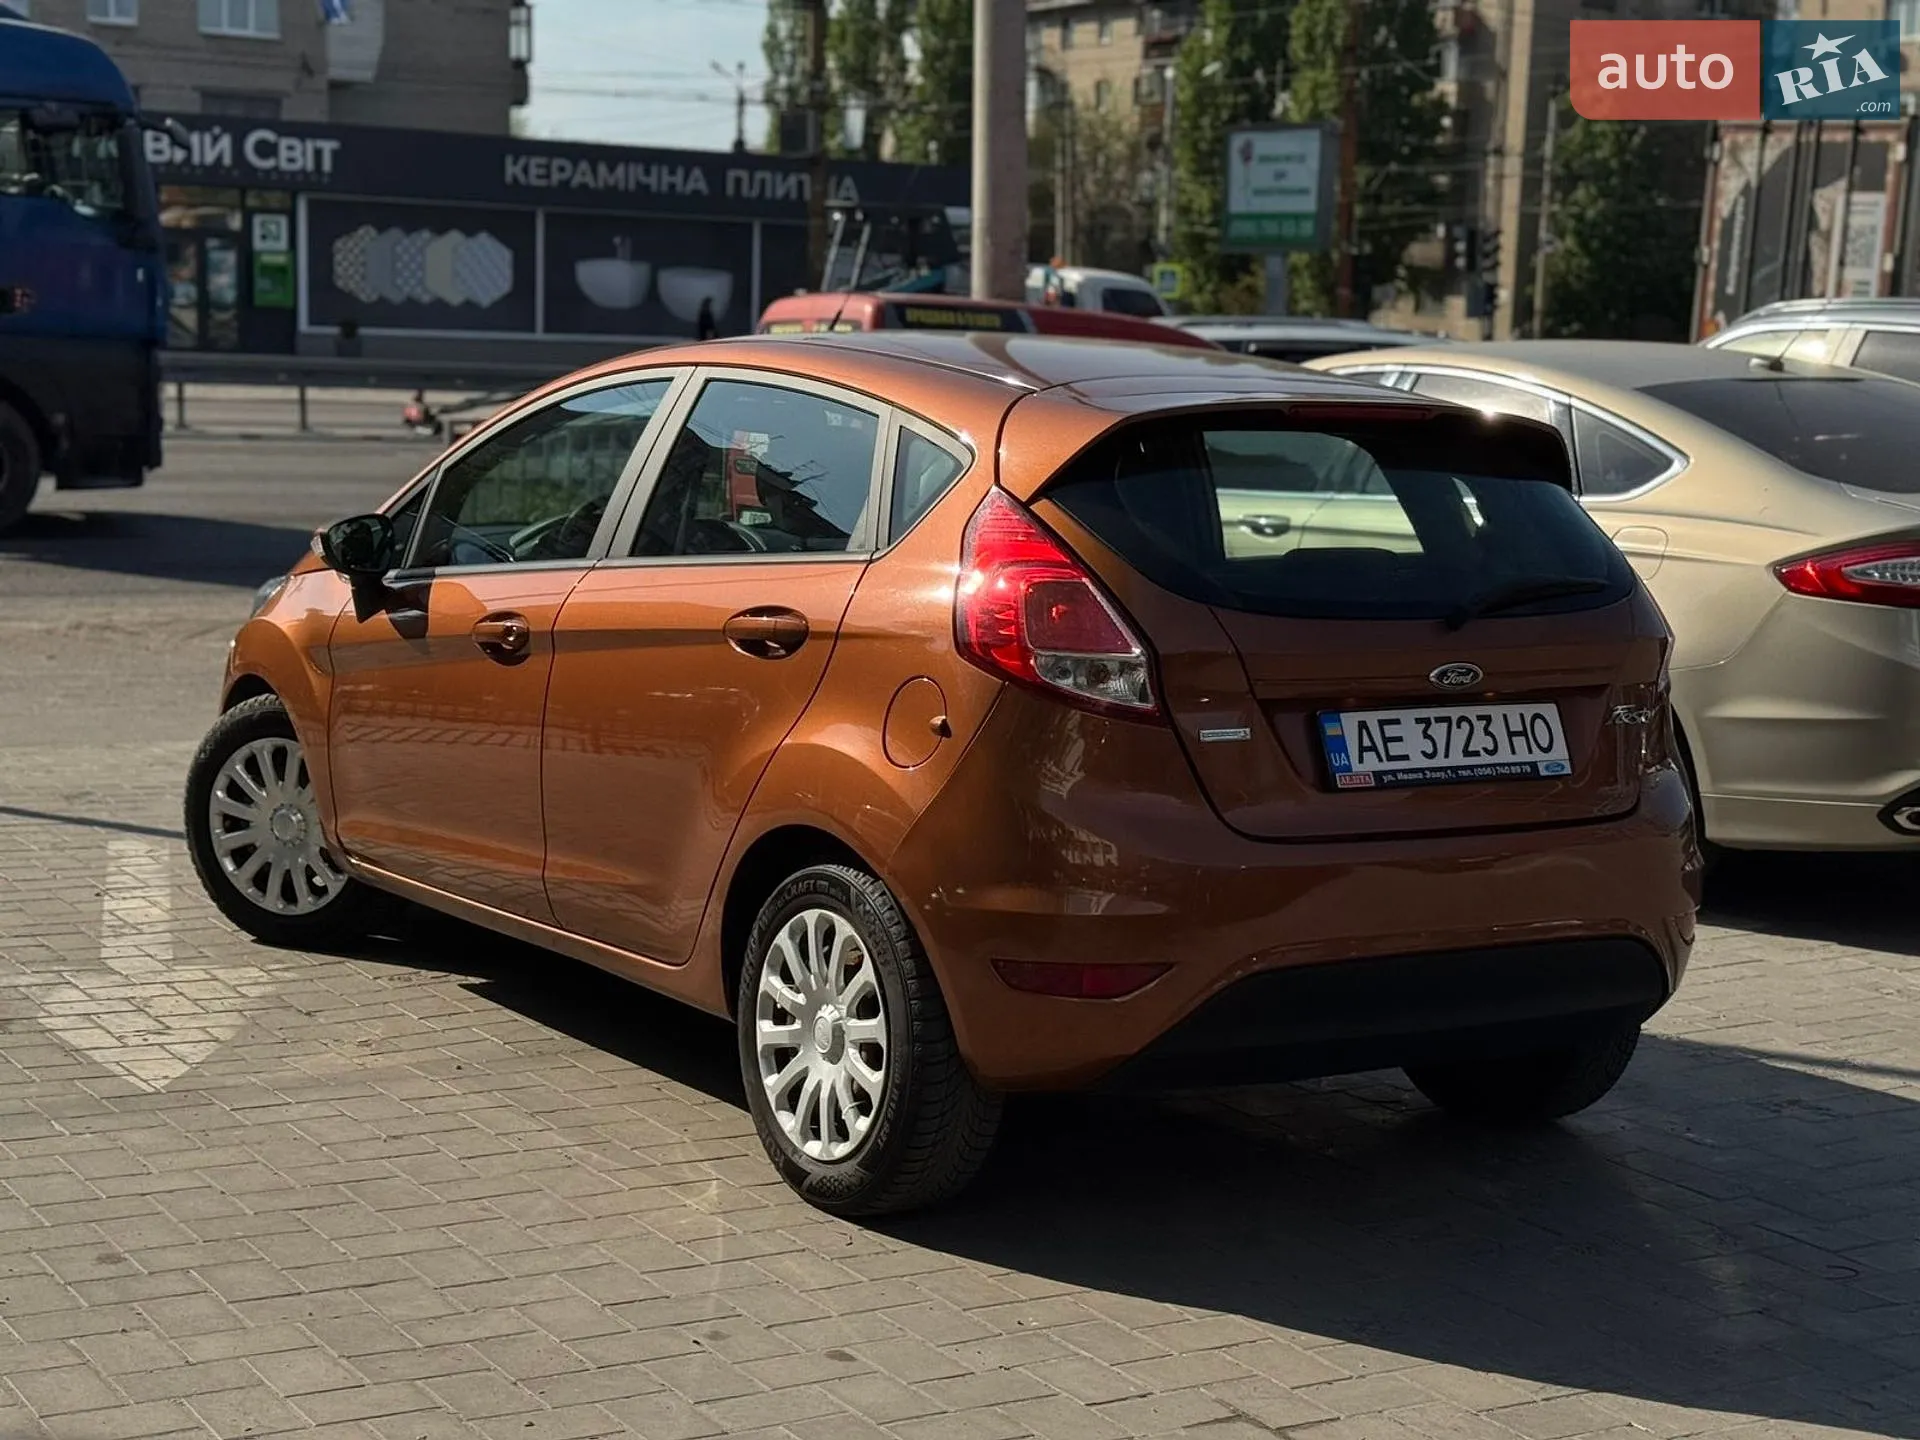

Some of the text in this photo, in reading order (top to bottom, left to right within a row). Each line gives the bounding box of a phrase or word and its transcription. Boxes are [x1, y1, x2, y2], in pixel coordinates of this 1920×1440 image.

[504, 154, 709, 196] КЕРАМІЧНА
[1442, 668, 1474, 685] Ford
[1357, 711, 1554, 764] AE 3723 HO
[1330, 752, 1350, 767] UA
